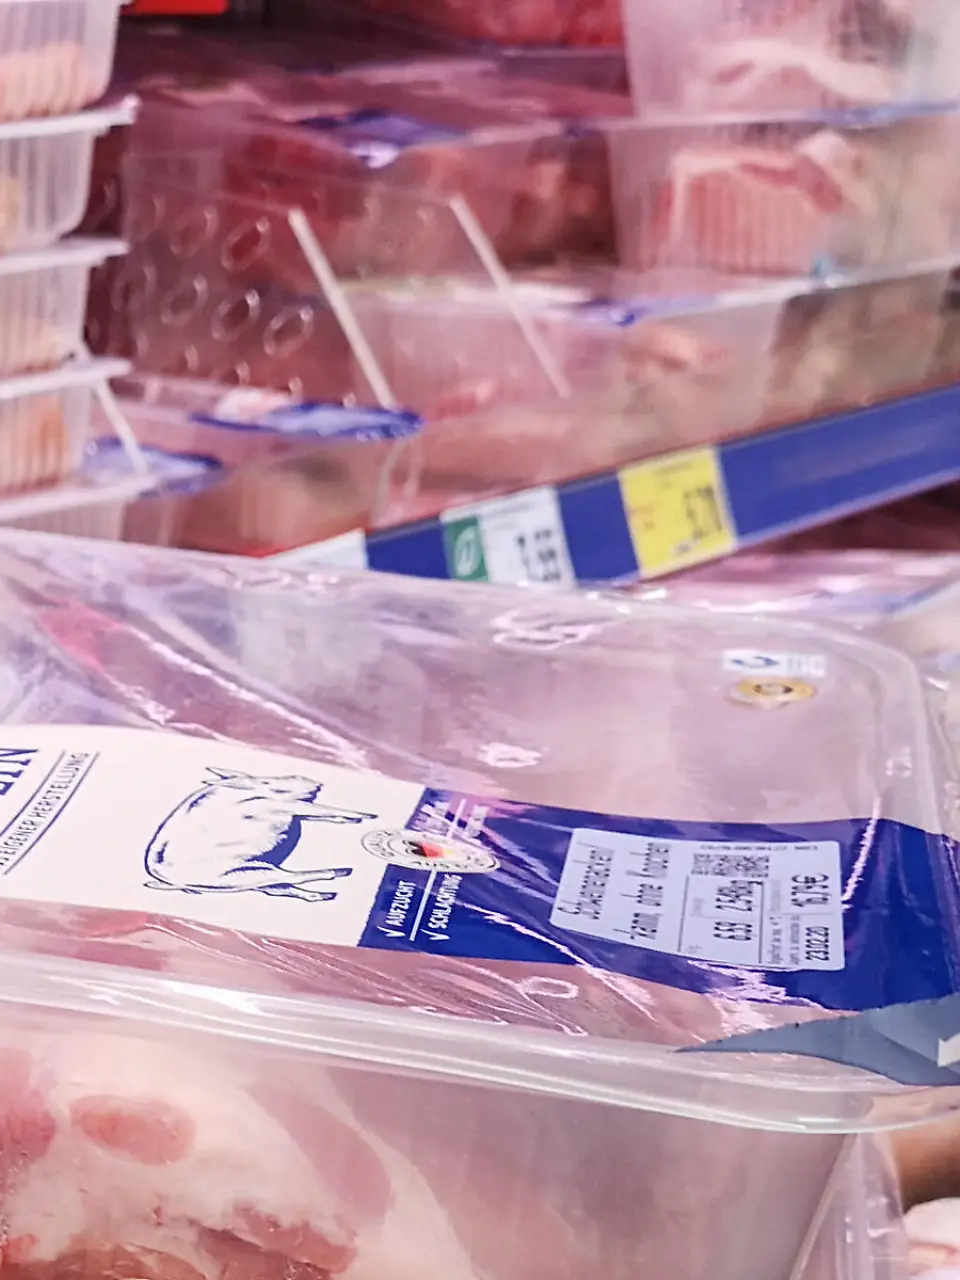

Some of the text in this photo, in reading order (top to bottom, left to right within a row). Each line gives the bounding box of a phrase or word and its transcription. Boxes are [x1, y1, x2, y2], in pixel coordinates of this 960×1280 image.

[27, 752, 90, 818] HERSTELLUNG
[385, 880, 417, 926] AUFZUCHT
[428, 873, 463, 929] SCHLACHTUNG
[619, 883, 663, 907] ohne
